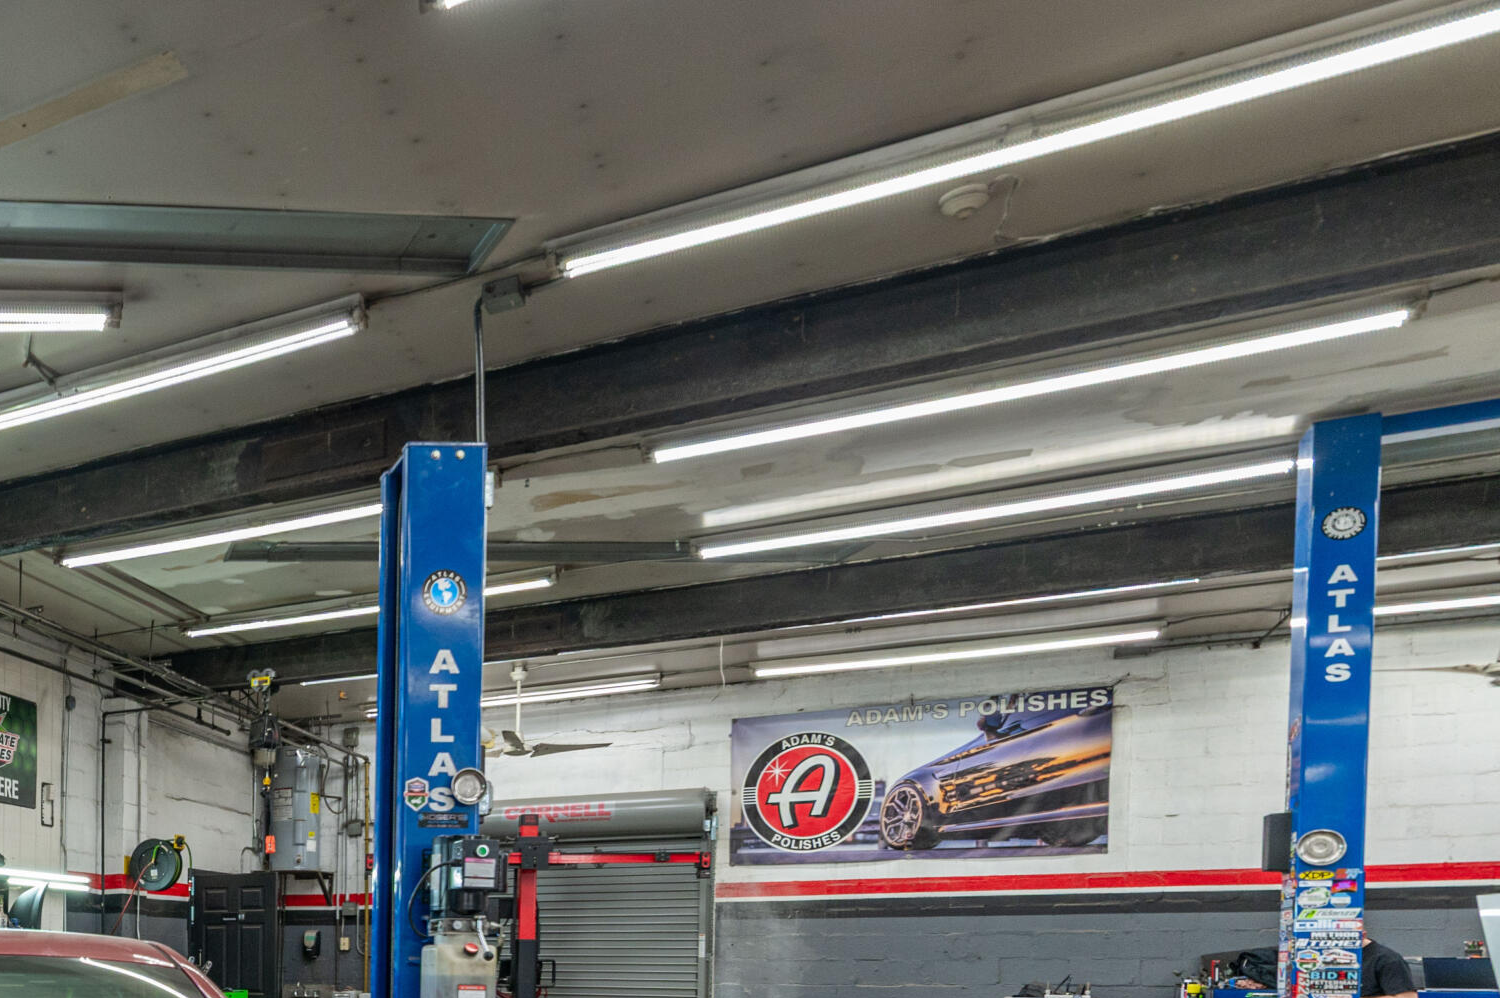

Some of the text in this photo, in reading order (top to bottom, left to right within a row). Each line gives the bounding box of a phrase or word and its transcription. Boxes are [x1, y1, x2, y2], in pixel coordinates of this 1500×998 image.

[1324, 564, 1359, 682] ATLAS
[846, 689, 1109, 727] ADAM'S POLISHES
[428, 649, 460, 812] ATLAS
[781, 733, 836, 750] ADAM'S
[771, 831, 841, 850] POLISHES
